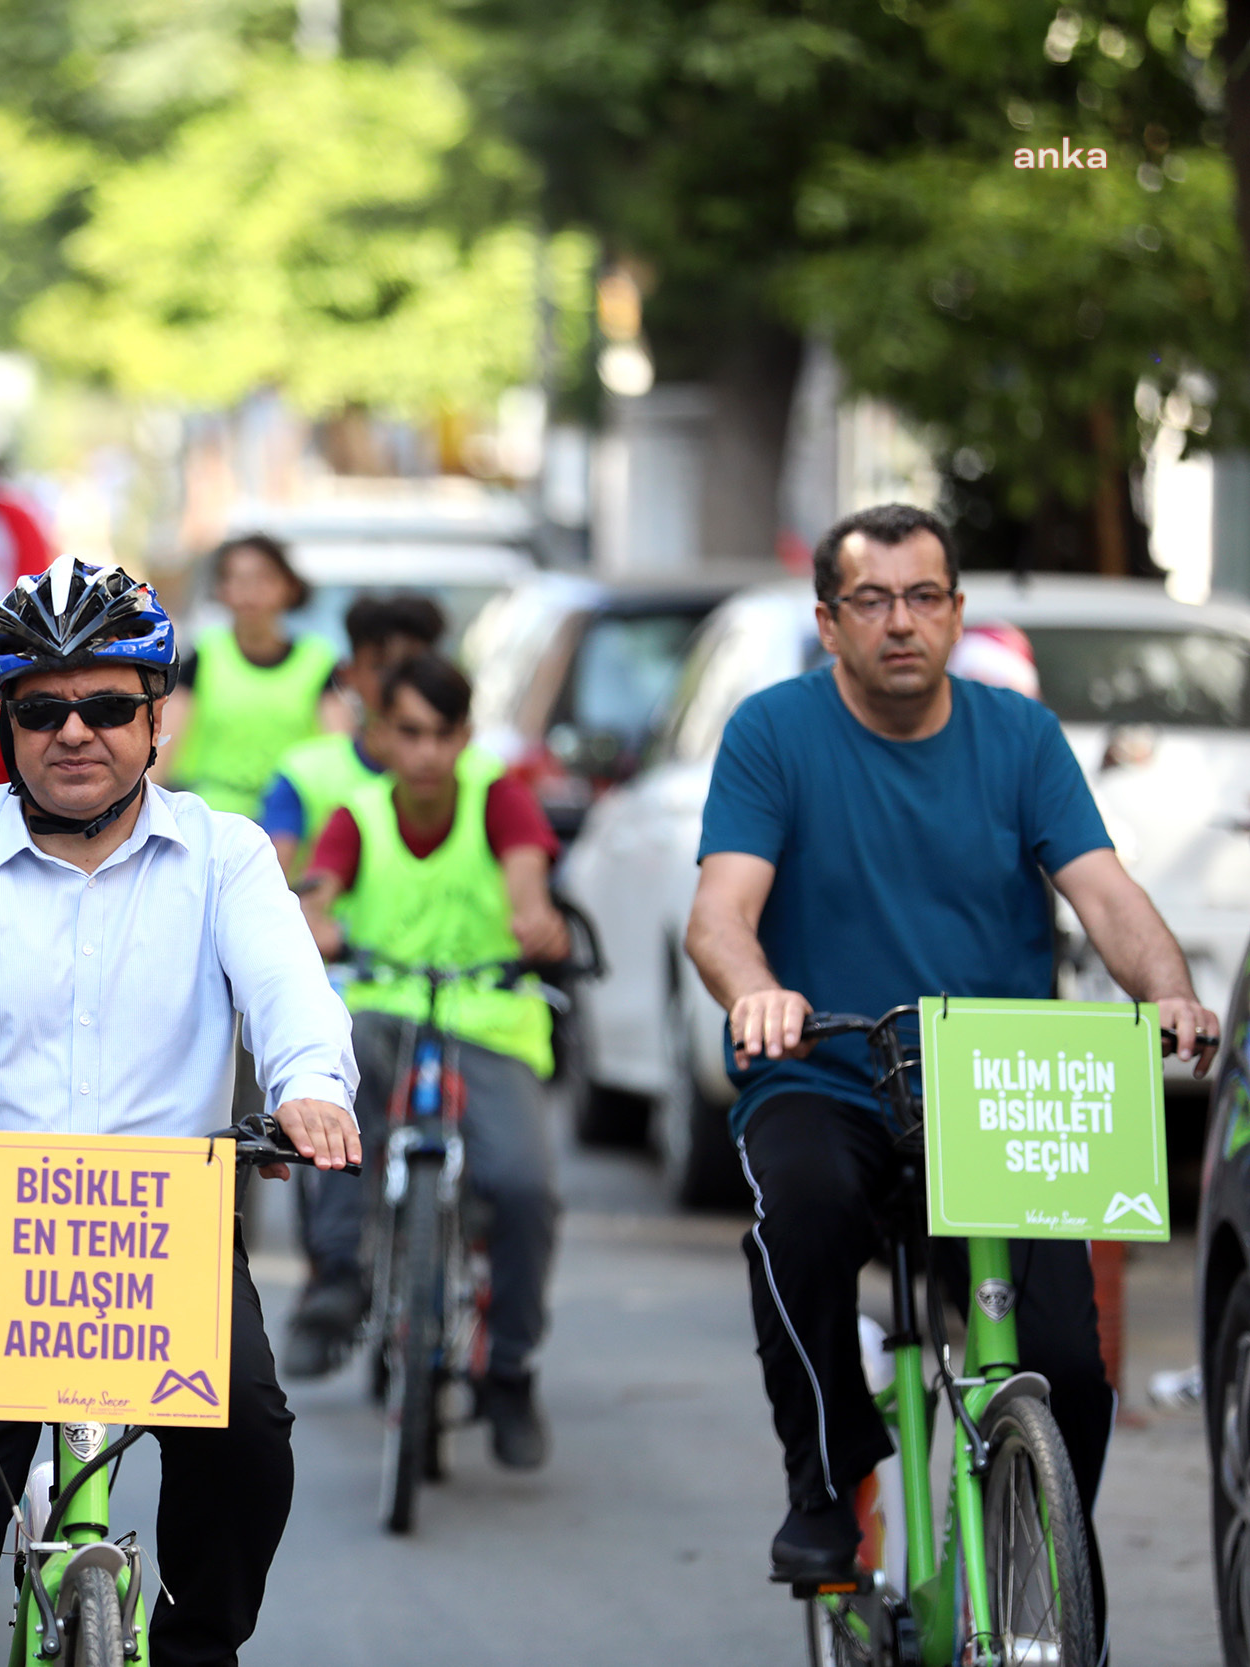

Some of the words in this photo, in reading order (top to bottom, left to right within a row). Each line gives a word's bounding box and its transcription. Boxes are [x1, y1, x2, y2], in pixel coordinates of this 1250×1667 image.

[972, 1049, 1050, 1091] İKLİM
[1058, 1050, 1115, 1100] İÇİN
[978, 1090, 1113, 1134] BİSİKLETİ
[1005, 1133, 1089, 1181] SEÇİN
[16, 1156, 171, 1208] BİSİKLET
[13, 1218, 55, 1255] EN
[67, 1211, 170, 1259] TEMİZ
[24, 1269, 154, 1319] ULAŞIM
[4, 1320, 171, 1362] ARACIDIR
[57, 1387, 96, 1413] Vahap
